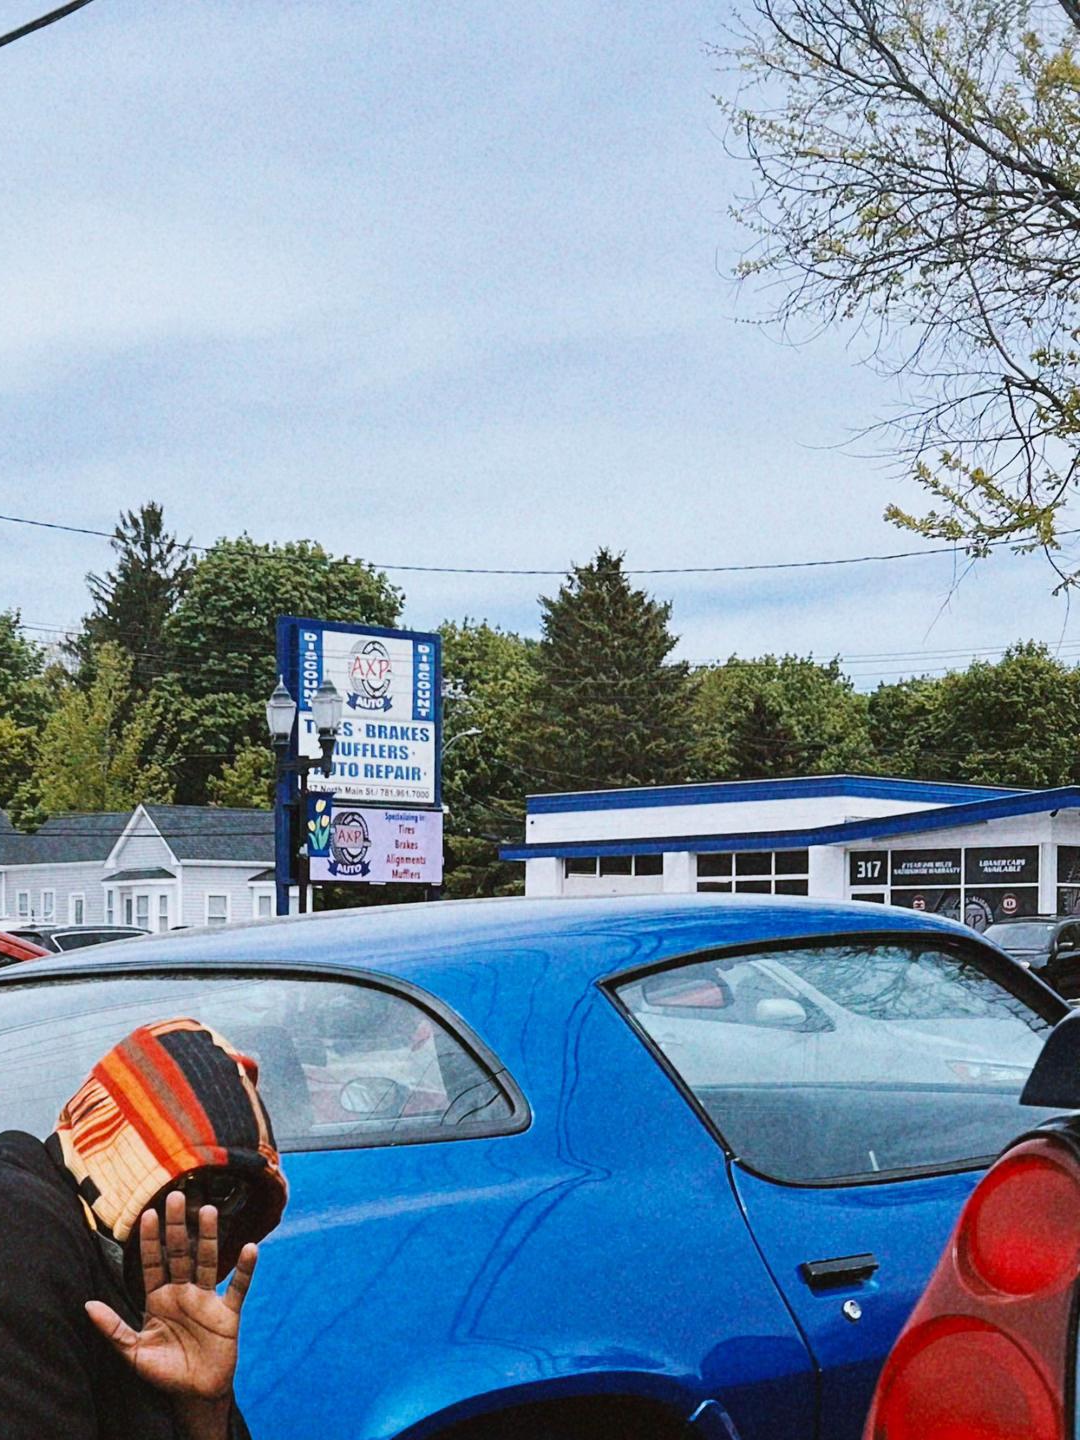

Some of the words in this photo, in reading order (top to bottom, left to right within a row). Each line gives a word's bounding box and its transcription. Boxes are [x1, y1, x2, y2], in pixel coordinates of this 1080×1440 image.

[303, 632, 319, 708] DISCOUNT
[351, 655, 390, 680] AXP
[417, 644, 431, 717] DISCOUNT
[355, 698, 385, 709] AUTO
[304, 719, 353, 737] TES
[365, 723, 430, 742] BRAKES
[363, 763, 422, 781] REPAIR
[345, 786, 364, 795] Main
[398, 824, 415, 835] Tires
[337, 829, 362, 843] AXP
[394, 840, 419, 850] Brakes
[386, 855, 426, 865] Alignments
[336, 864, 362, 873] AUTO
[857, 861, 881, 878] 317
[928, 866, 961, 875] WARRANTY
[982, 865, 1022, 873] AVAILABLE
[391, 869, 421, 880] Mufflers
